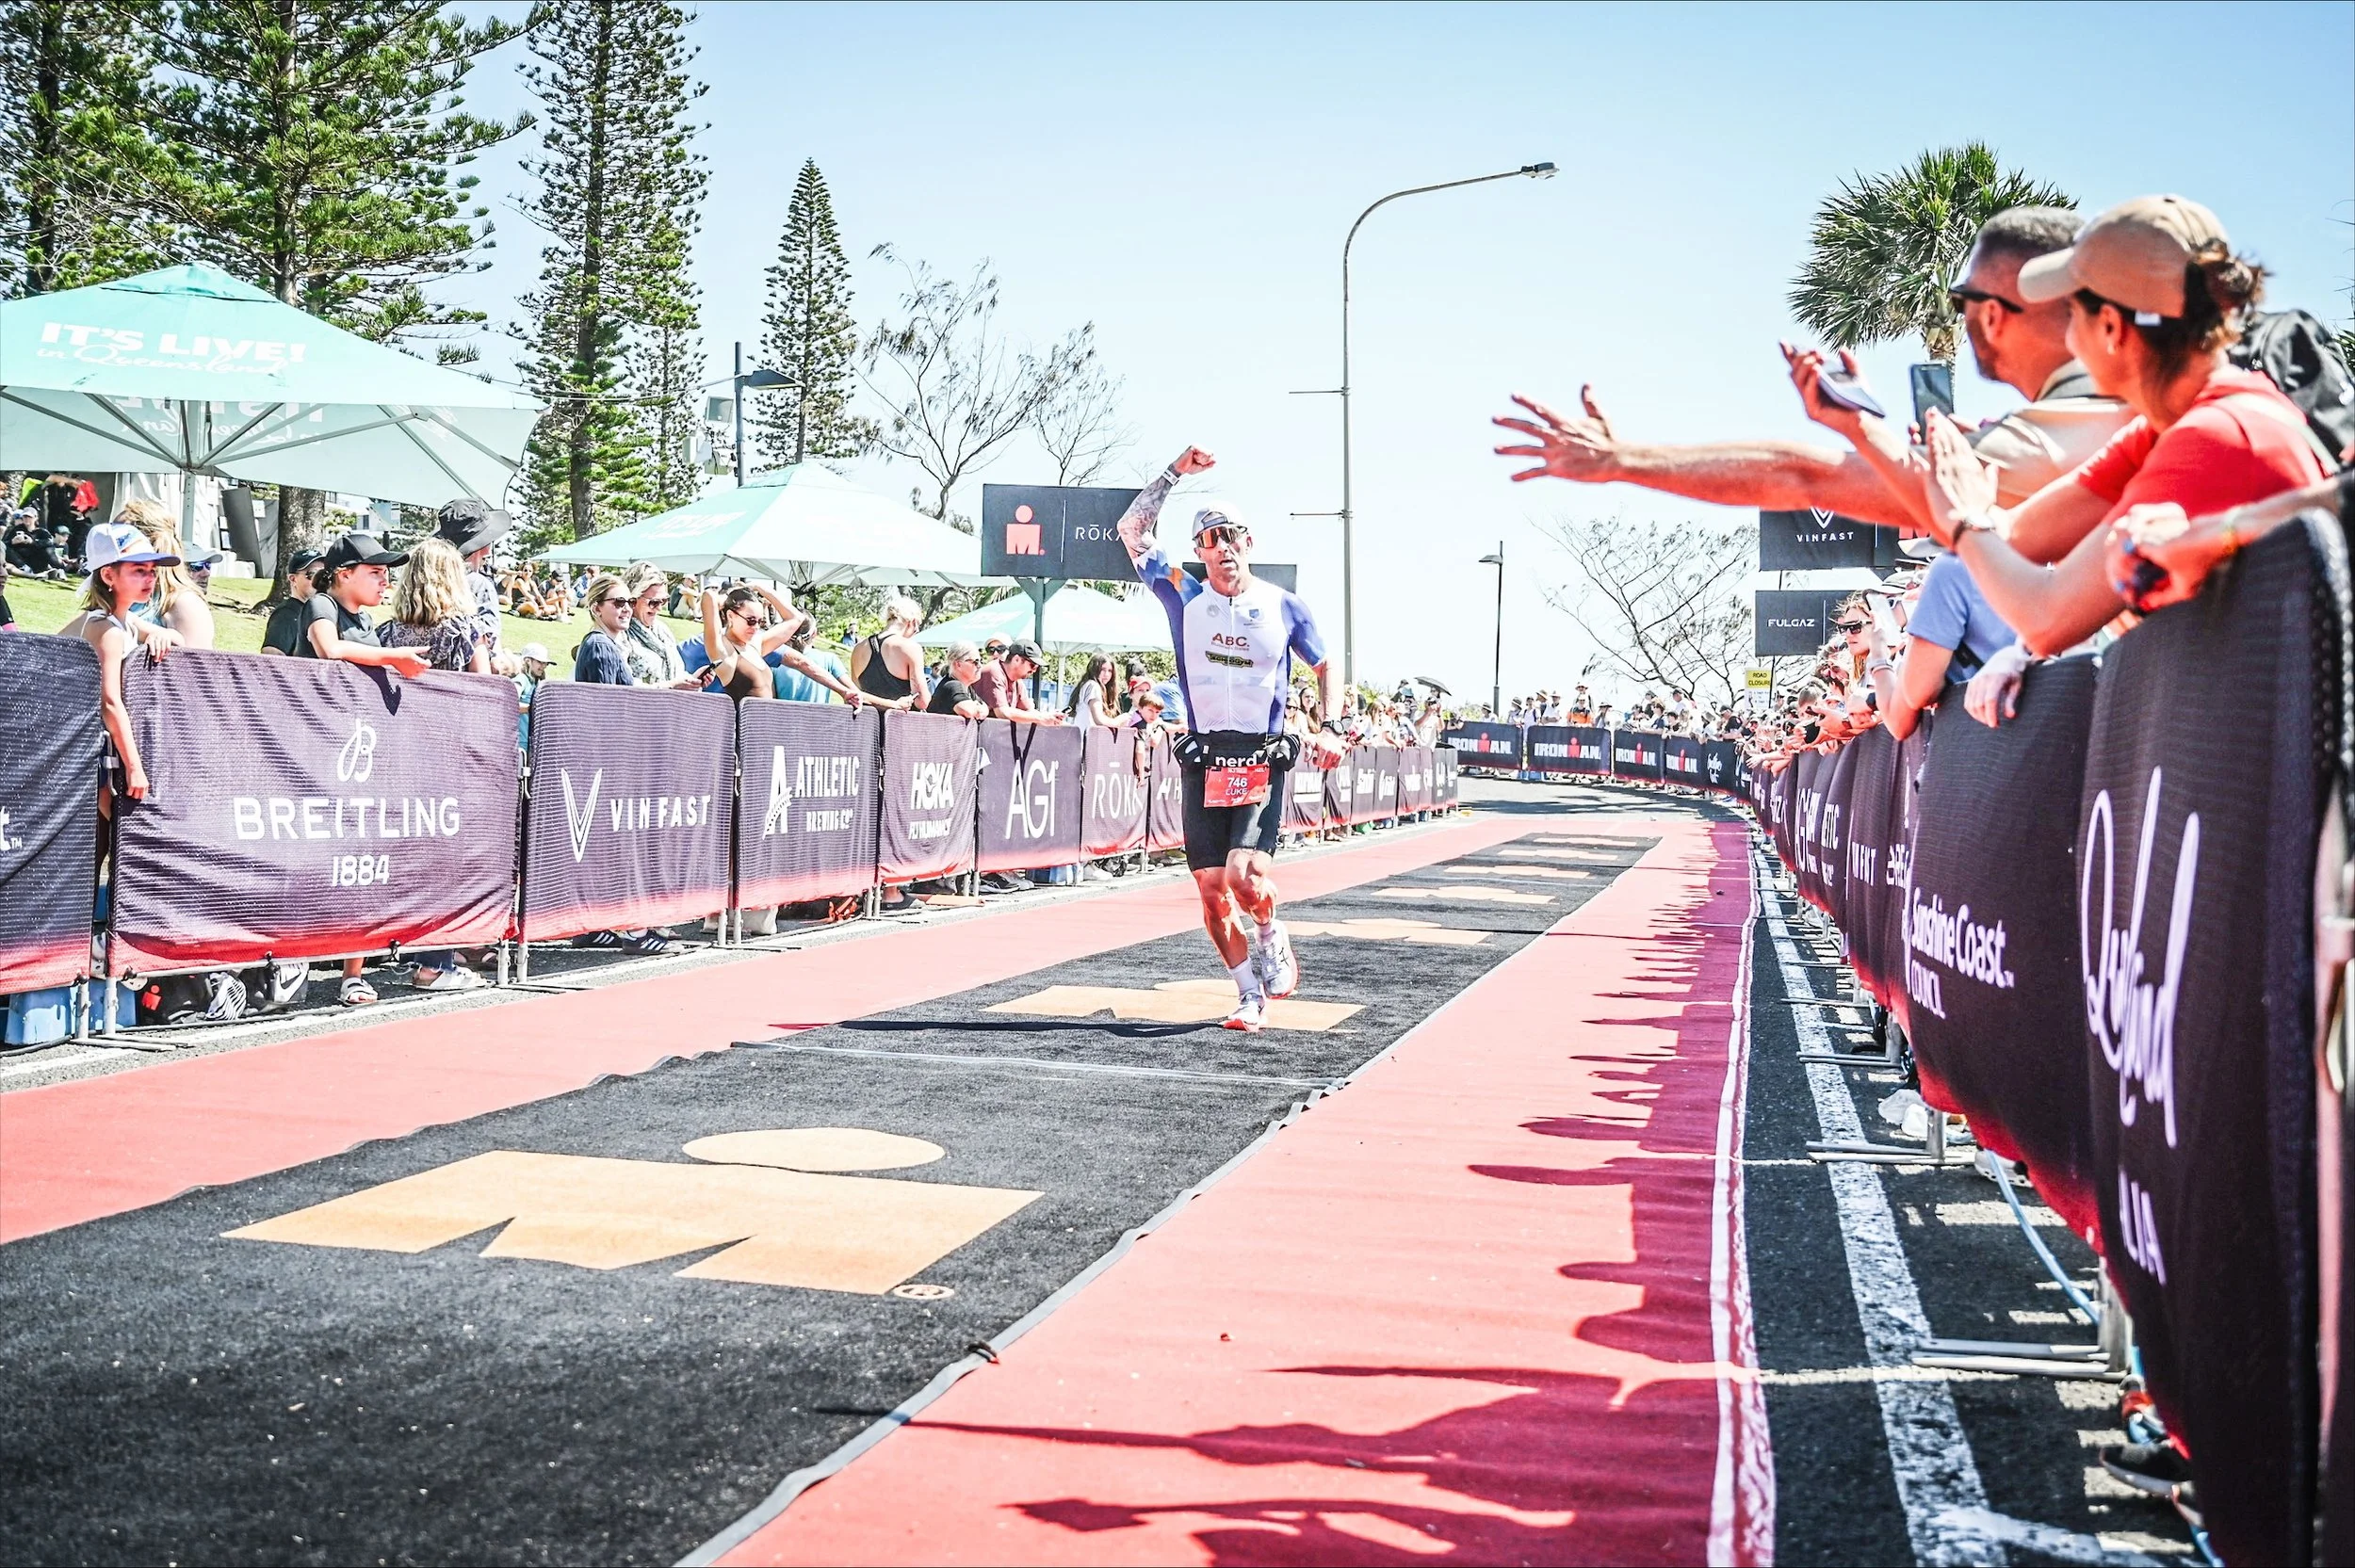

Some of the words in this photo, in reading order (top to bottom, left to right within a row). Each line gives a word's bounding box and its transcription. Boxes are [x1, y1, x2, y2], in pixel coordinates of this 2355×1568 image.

[73, 344, 289, 375] Queensland
[158, 332, 307, 363] LIVE!
[1795, 531, 1854, 542] VINFAST
[1767, 618, 1815, 627] FULGAZ
[1215, 754, 1258, 767] nerd
[1534, 737, 1600, 760] IRONMAN
[1616, 743, 1656, 766] IRONMAN
[795, 756, 859, 798] ATHLETIC
[911, 762, 954, 810] HOKA
[1227, 777, 1247, 787] 746
[234, 798, 461, 840] BREITLING
[332, 855, 390, 887] 1884
[1911, 887, 1956, 969] Sunshine
